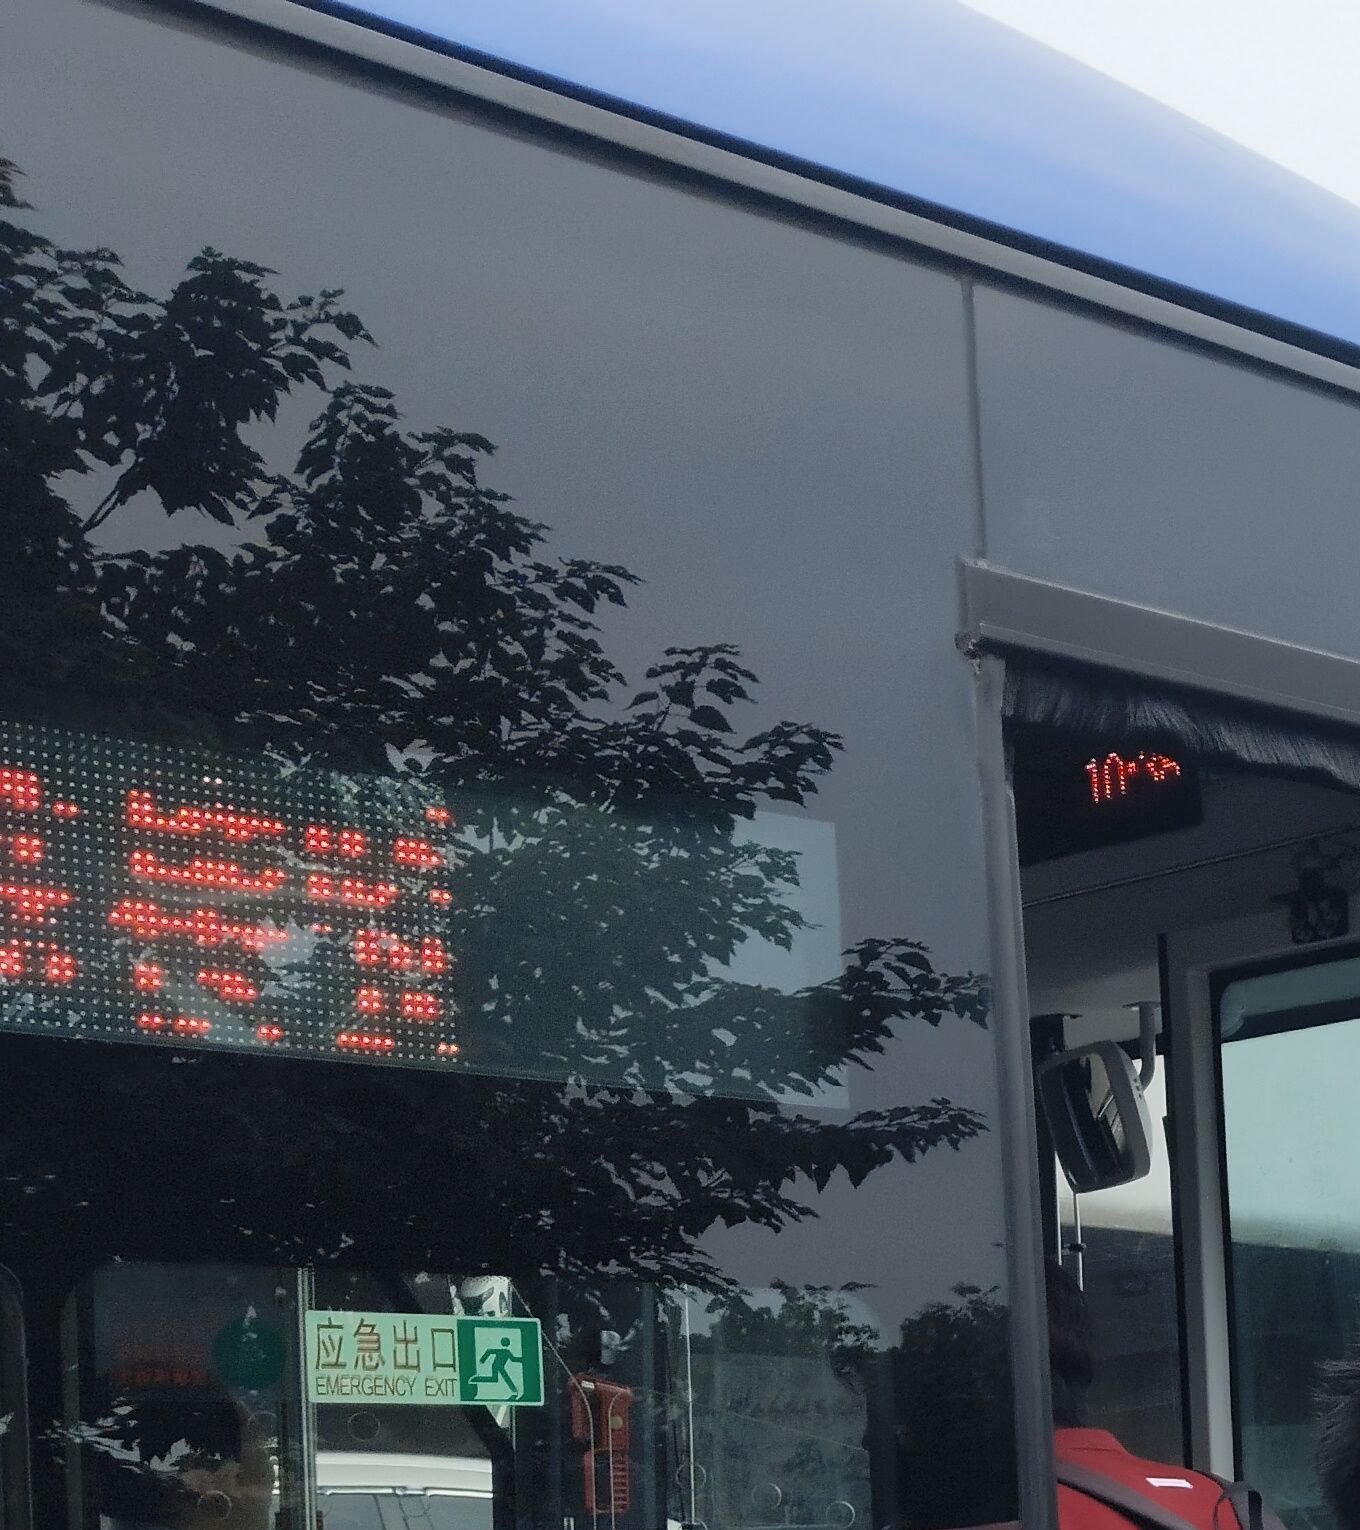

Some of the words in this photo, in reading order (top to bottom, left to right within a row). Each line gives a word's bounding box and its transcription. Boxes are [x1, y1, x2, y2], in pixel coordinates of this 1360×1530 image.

[315, 1317, 457, 1372] 应急出口
[316, 1376, 416, 1397] EMERGENCY
[425, 1378, 457, 1397] EXIT
